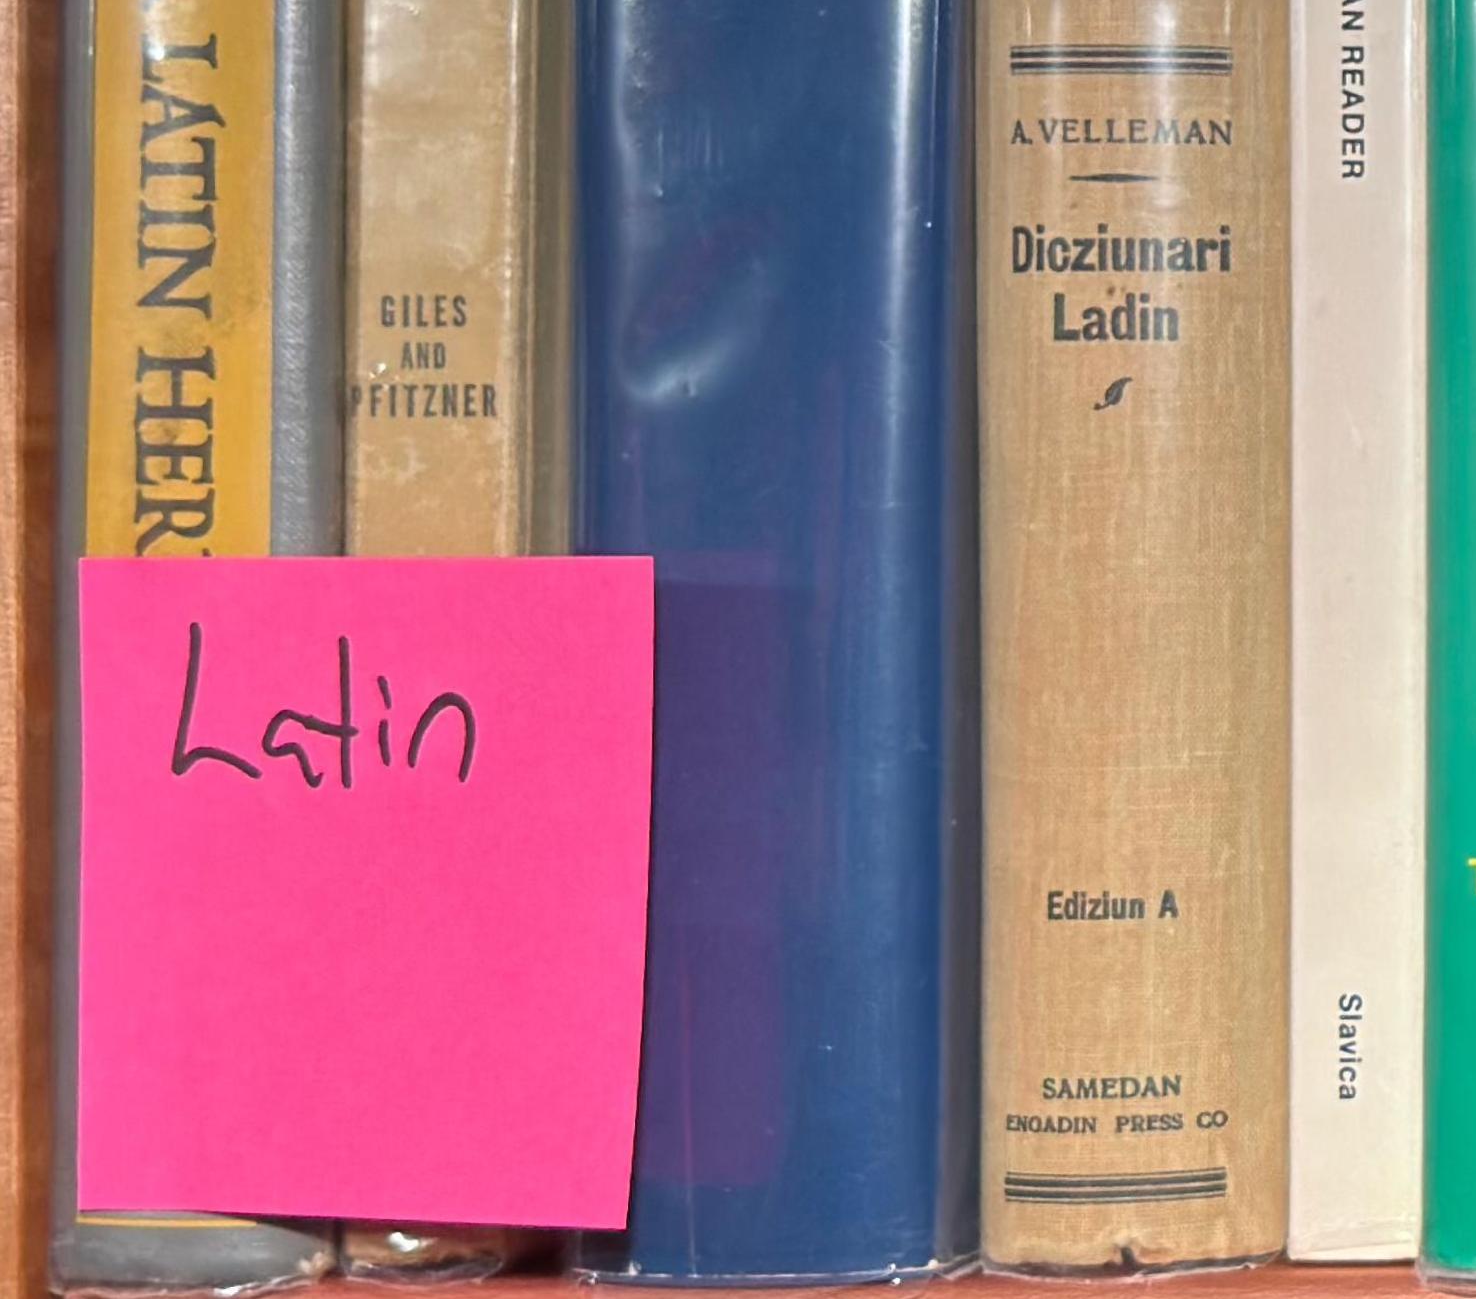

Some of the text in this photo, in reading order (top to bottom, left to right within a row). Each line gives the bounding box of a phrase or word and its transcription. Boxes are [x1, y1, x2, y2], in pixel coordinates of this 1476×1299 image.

[1039, 119, 1232, 145] VELLEMAN
[1341, 45, 1366, 180] READER
[136, 34, 227, 320] LATIN
[1012, 223, 1231, 273] Dicziunari
[381, 295, 468, 329] GILES
[1053, 292, 1179, 341] Ladin
[402, 342, 446, 370] AND
[350, 384, 498, 418] PFITZNER
[134, 347, 217, 557] HER
[172, 621, 477, 789] Latin
[1047, 889, 1179, 920] Ediziun A
[1338, 993, 1363, 1100] Slavica
[1042, 1075, 1182, 1100] SAMEDAN
[1115, 1113, 1184, 1133] PRESS
[1196, 1110, 1229, 1129] CO
